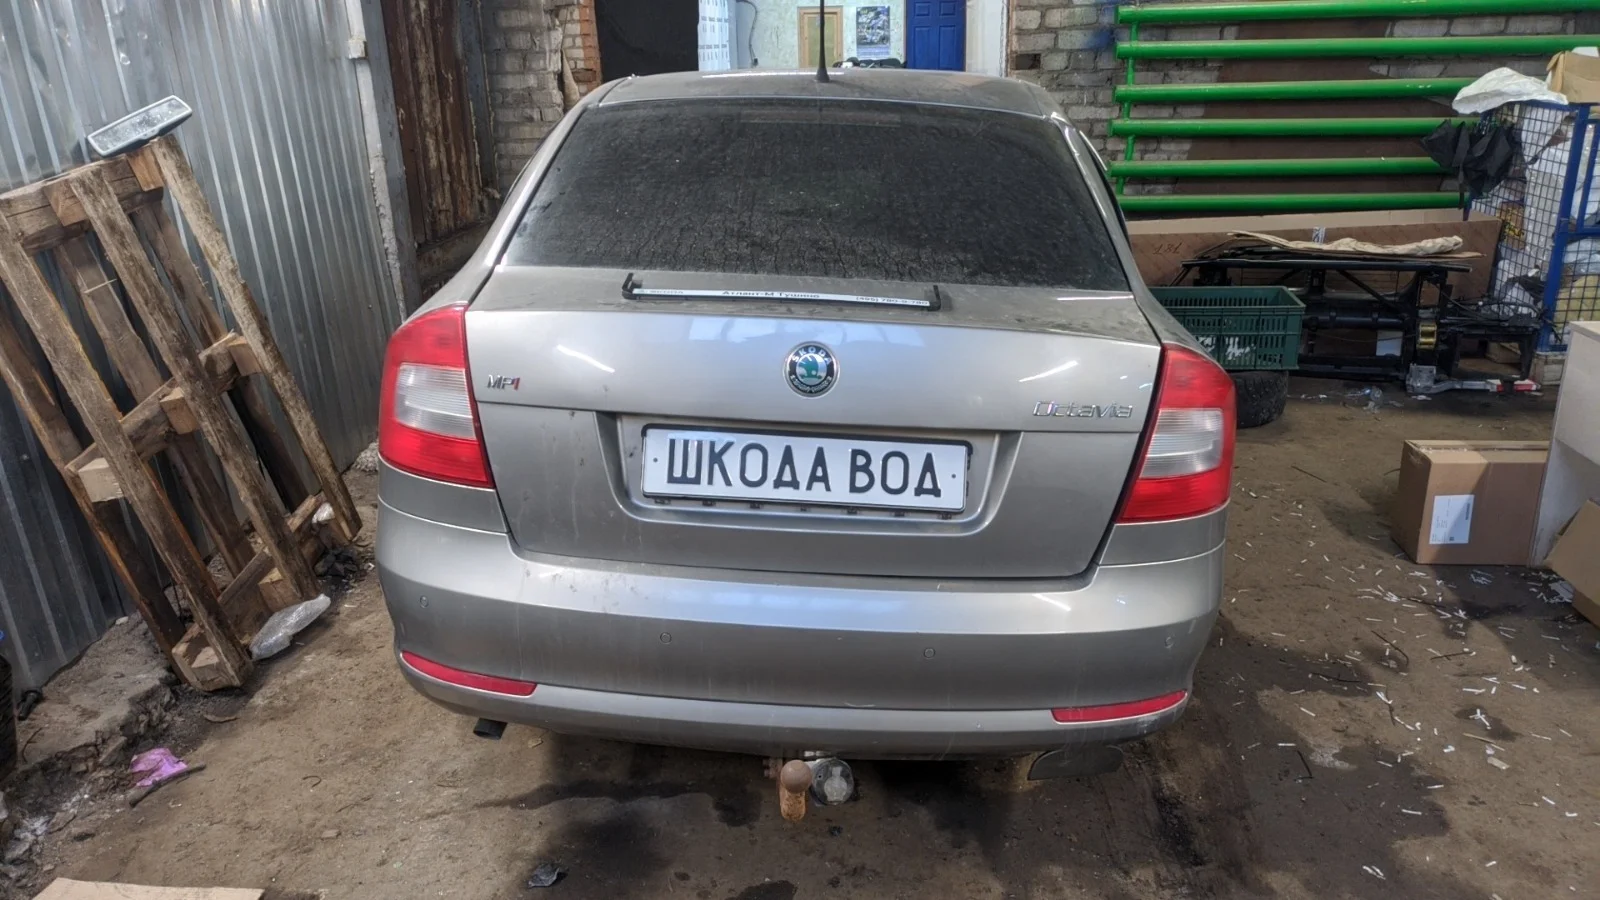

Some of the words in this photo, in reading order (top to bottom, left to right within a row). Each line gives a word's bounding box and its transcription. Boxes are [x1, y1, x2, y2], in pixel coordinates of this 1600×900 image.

[1033, 401, 1133, 419] Octavia
[666, 437, 832, 492] ШКОДА
[849, 448, 942, 498] ВОД
